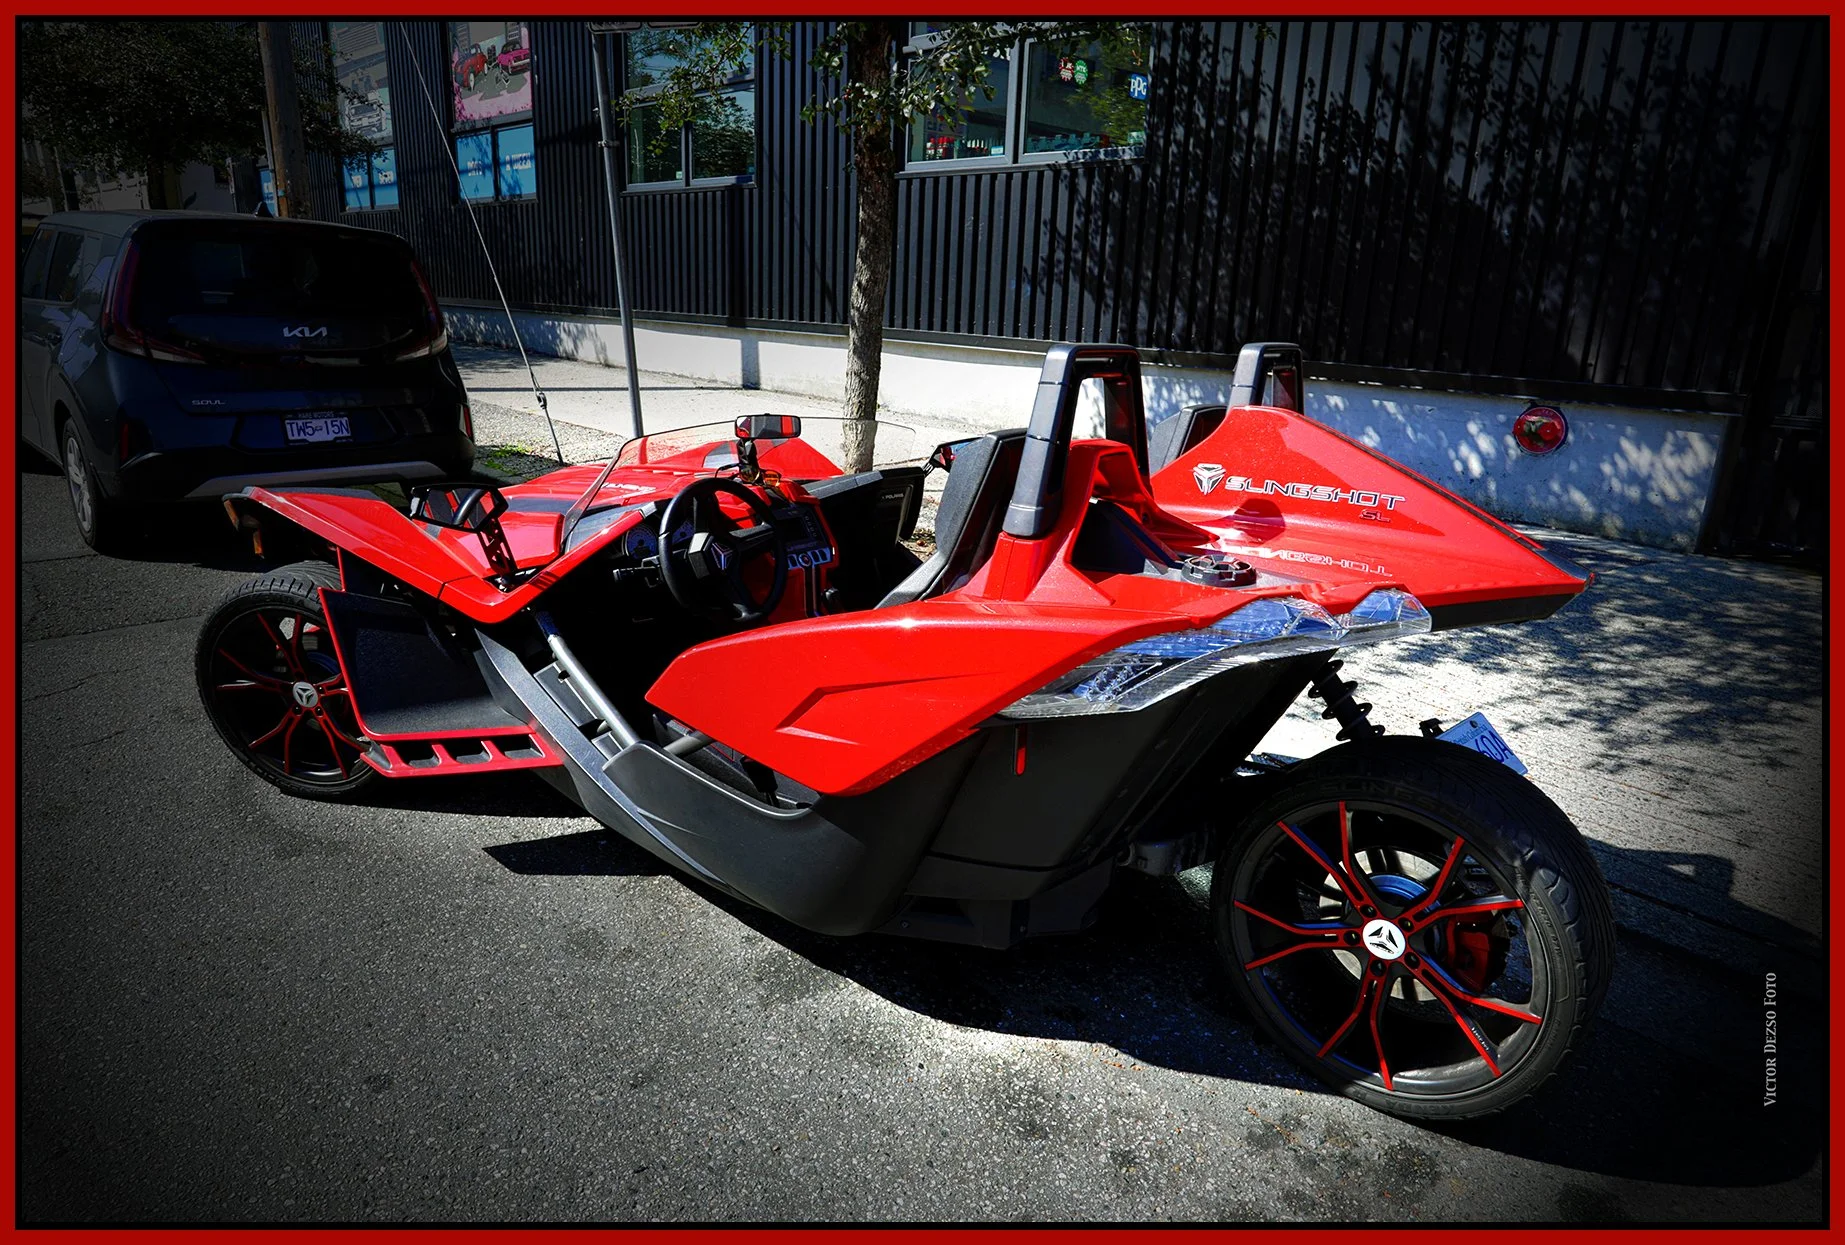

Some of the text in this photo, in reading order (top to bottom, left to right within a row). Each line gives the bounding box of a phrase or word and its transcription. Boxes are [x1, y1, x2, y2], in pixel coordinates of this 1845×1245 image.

[1130, 76, 1147, 97] PPG
[282, 326, 328, 338] KIA
[1225, 476, 1405, 510] SLINGSHOT
[1359, 509, 1391, 523] SL
